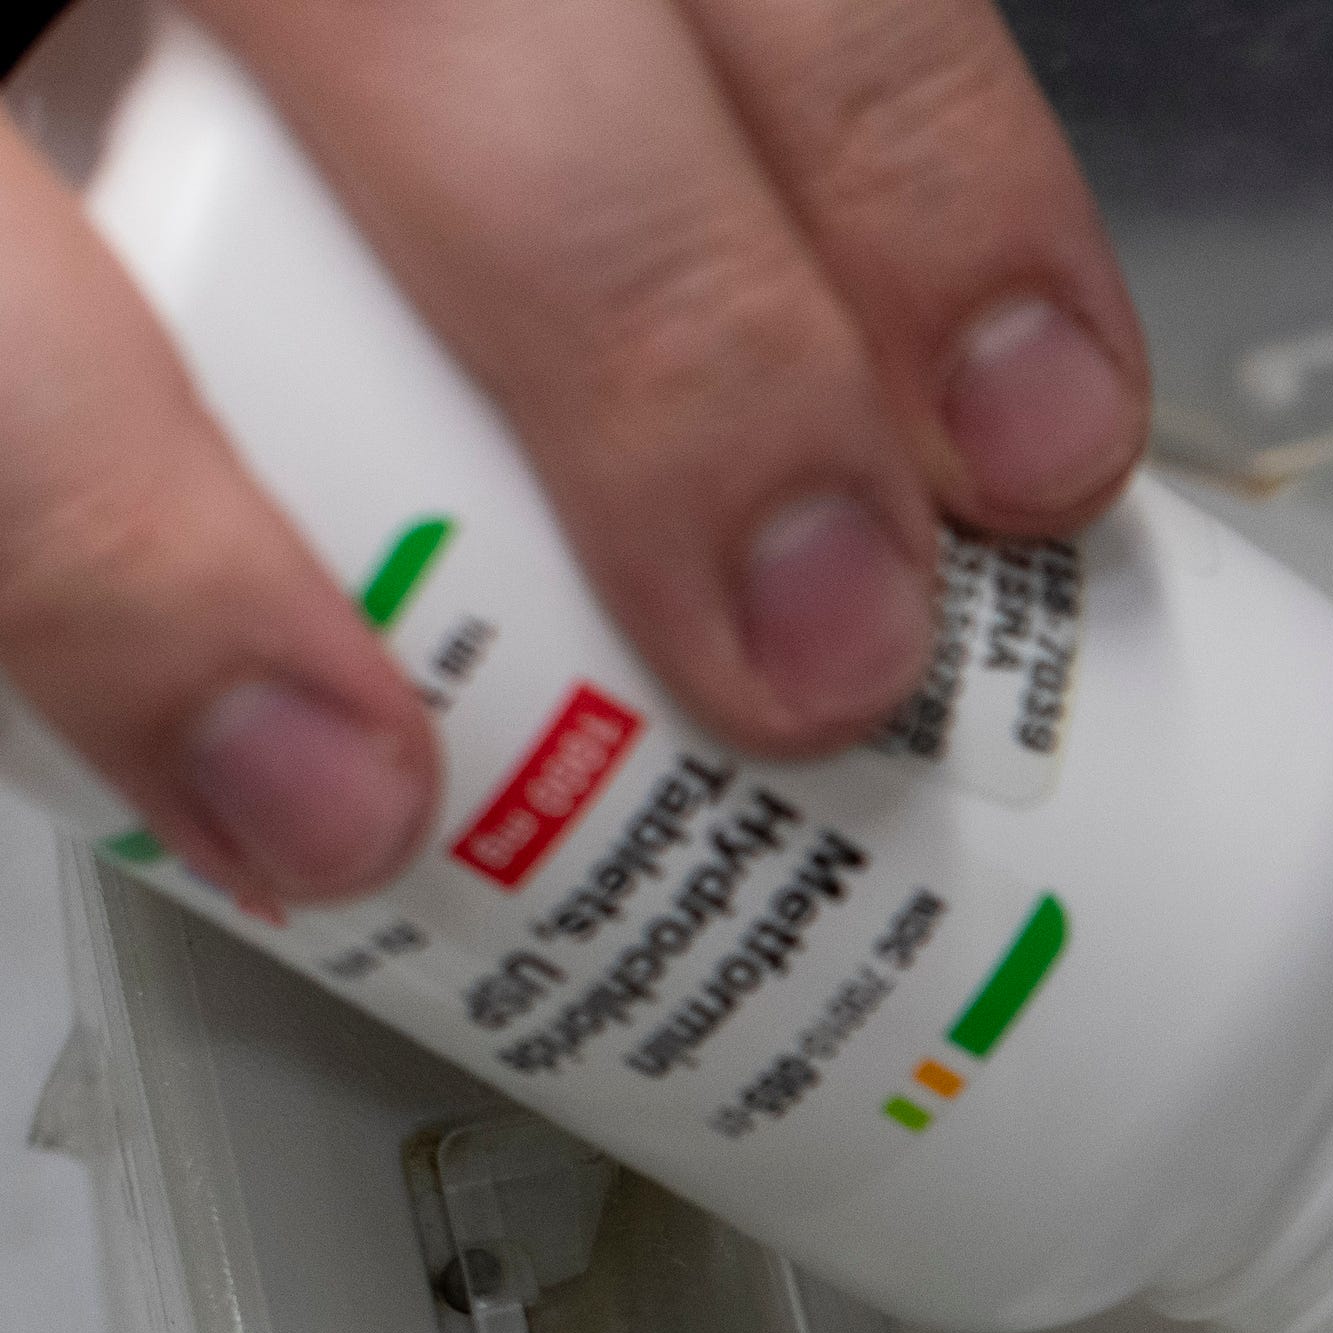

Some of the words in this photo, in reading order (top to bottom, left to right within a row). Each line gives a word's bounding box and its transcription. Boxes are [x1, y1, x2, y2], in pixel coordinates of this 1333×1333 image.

[524, 712, 622, 818] 1000
[530, 752, 735, 942] Tablets,
[626, 832, 870, 1078] Metformin
[873, 888, 945, 968] NDC
